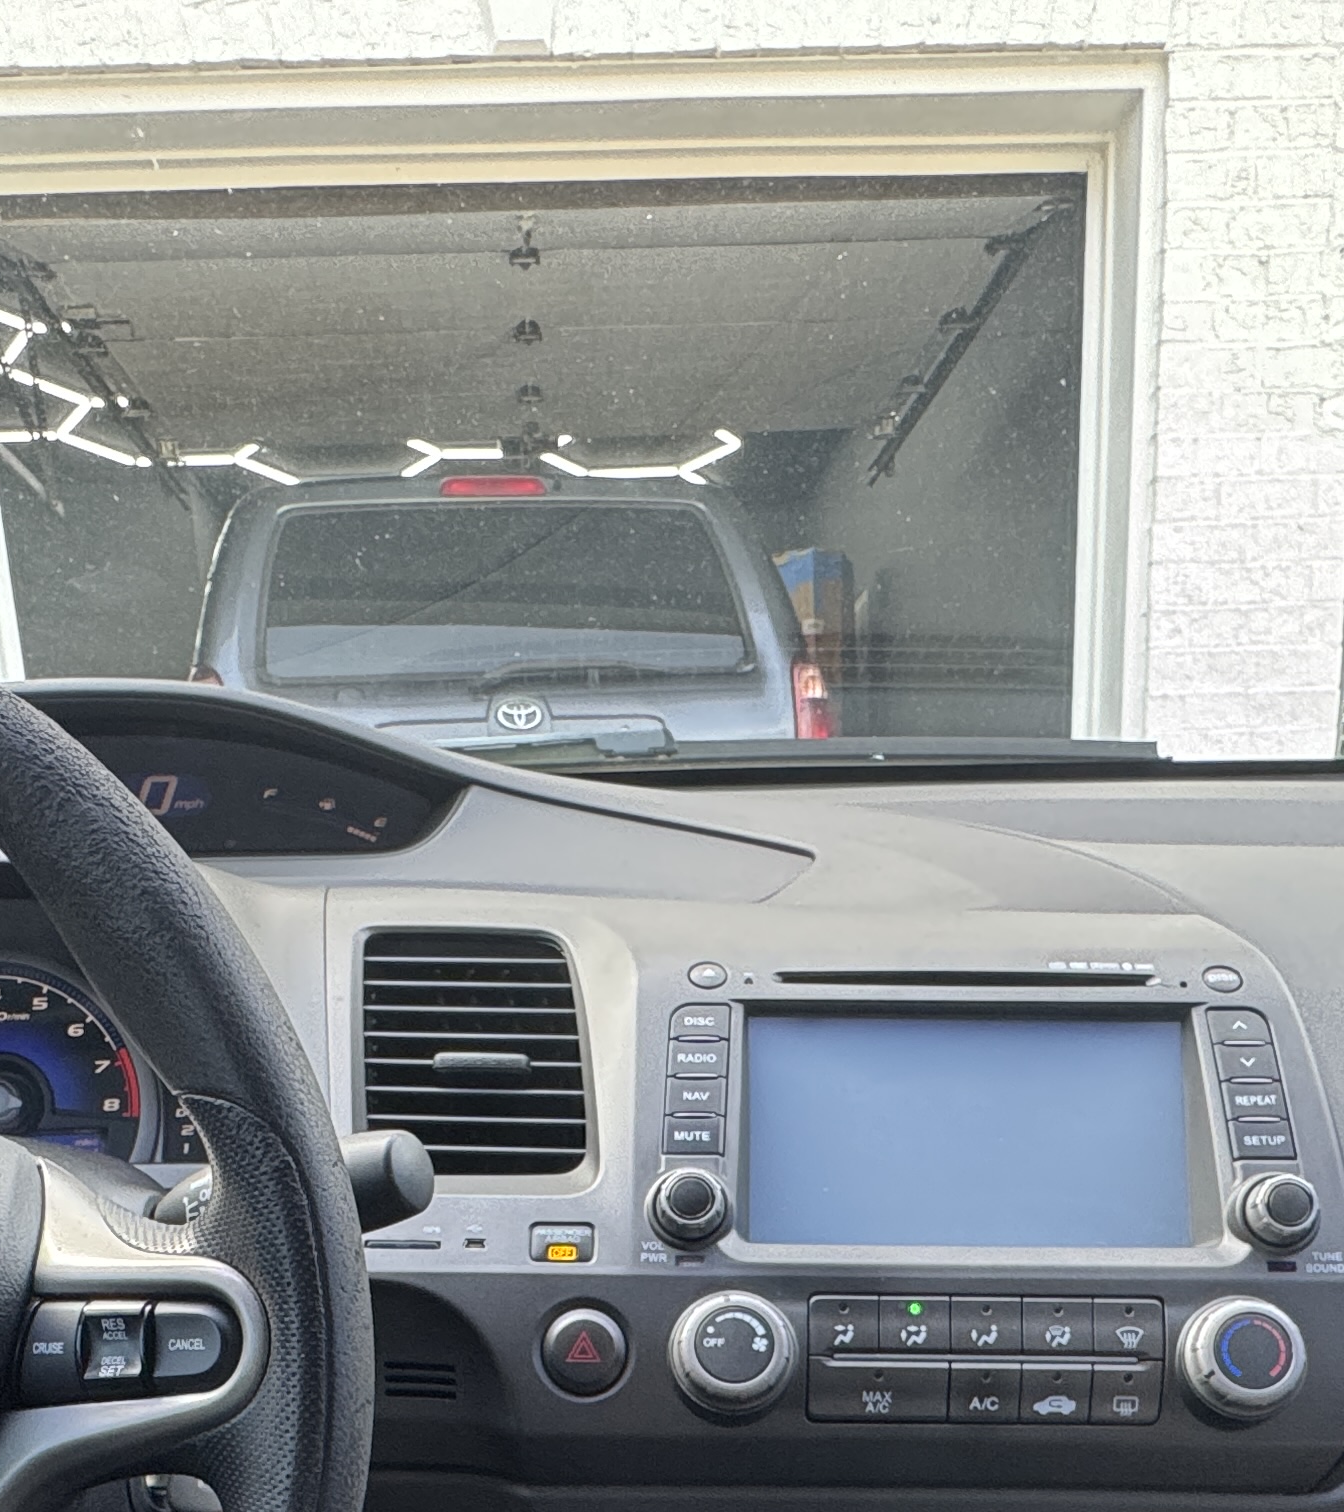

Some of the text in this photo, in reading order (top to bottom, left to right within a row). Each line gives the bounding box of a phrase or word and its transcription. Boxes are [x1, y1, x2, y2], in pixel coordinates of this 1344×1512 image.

[173, 799, 205, 811] mph
[31, 997, 49, 1011] 5
[683, 1016, 716, 1027] DISC
[67, 1023, 85, 1037] 6
[676, 1053, 717, 1063] RADIO
[94, 1059, 111, 1073] 7
[682, 1090, 711, 1101] NAV
[1235, 1094, 1277, 1106] REPEAT
[102, 1098, 121, 1112] 8
[673, 1130, 712, 1142] MUTE
[1243, 1135, 1287, 1146] SETUP
[640, 1241, 665, 1251] VOL
[640, 1253, 668, 1263] PWR
[1311, 1251, 1343, 1262] TUNE
[100, 1318, 126, 1331] RES
[102, 1331, 129, 1341] ACCEL
[32, 1342, 64, 1355] CRUISE
[167, 1338, 206, 1351] CANCEL
[702, 1337, 726, 1348] OFF
[100, 1356, 126, 1366] DECEL
[98, 1365, 125, 1377] SET
[862, 1390, 893, 1403] MAX
[864, 1402, 890, 1414] A/C
[968, 1396, 1000, 1412] A/C
